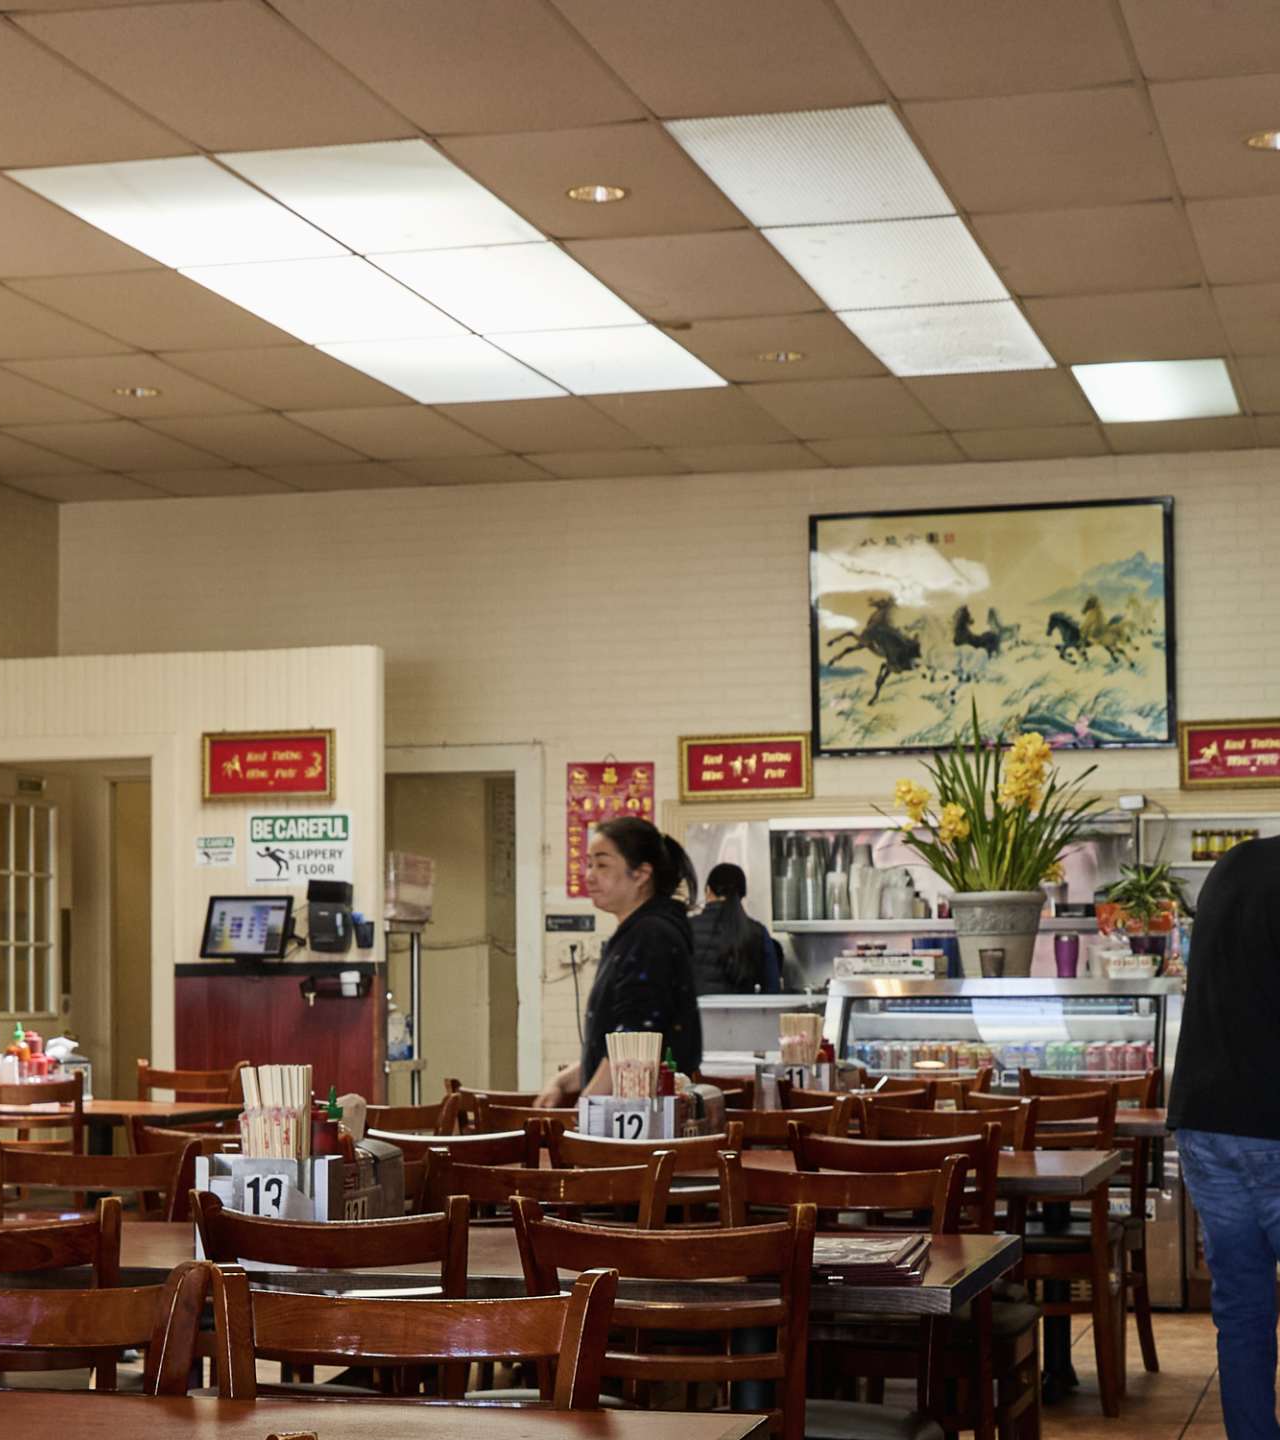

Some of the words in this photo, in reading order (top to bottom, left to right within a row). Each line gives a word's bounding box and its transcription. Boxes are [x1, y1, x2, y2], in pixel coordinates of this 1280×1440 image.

[253, 819, 273, 840] BE
[274, 818, 347, 840] CAREFUL
[288, 848, 344, 860] SLIPPERY
[297, 863, 335, 876] FLOOR
[786, 1068, 804, 1088] 11
[615, 1113, 643, 1139] 12
[246, 1176, 283, 1217] 13
